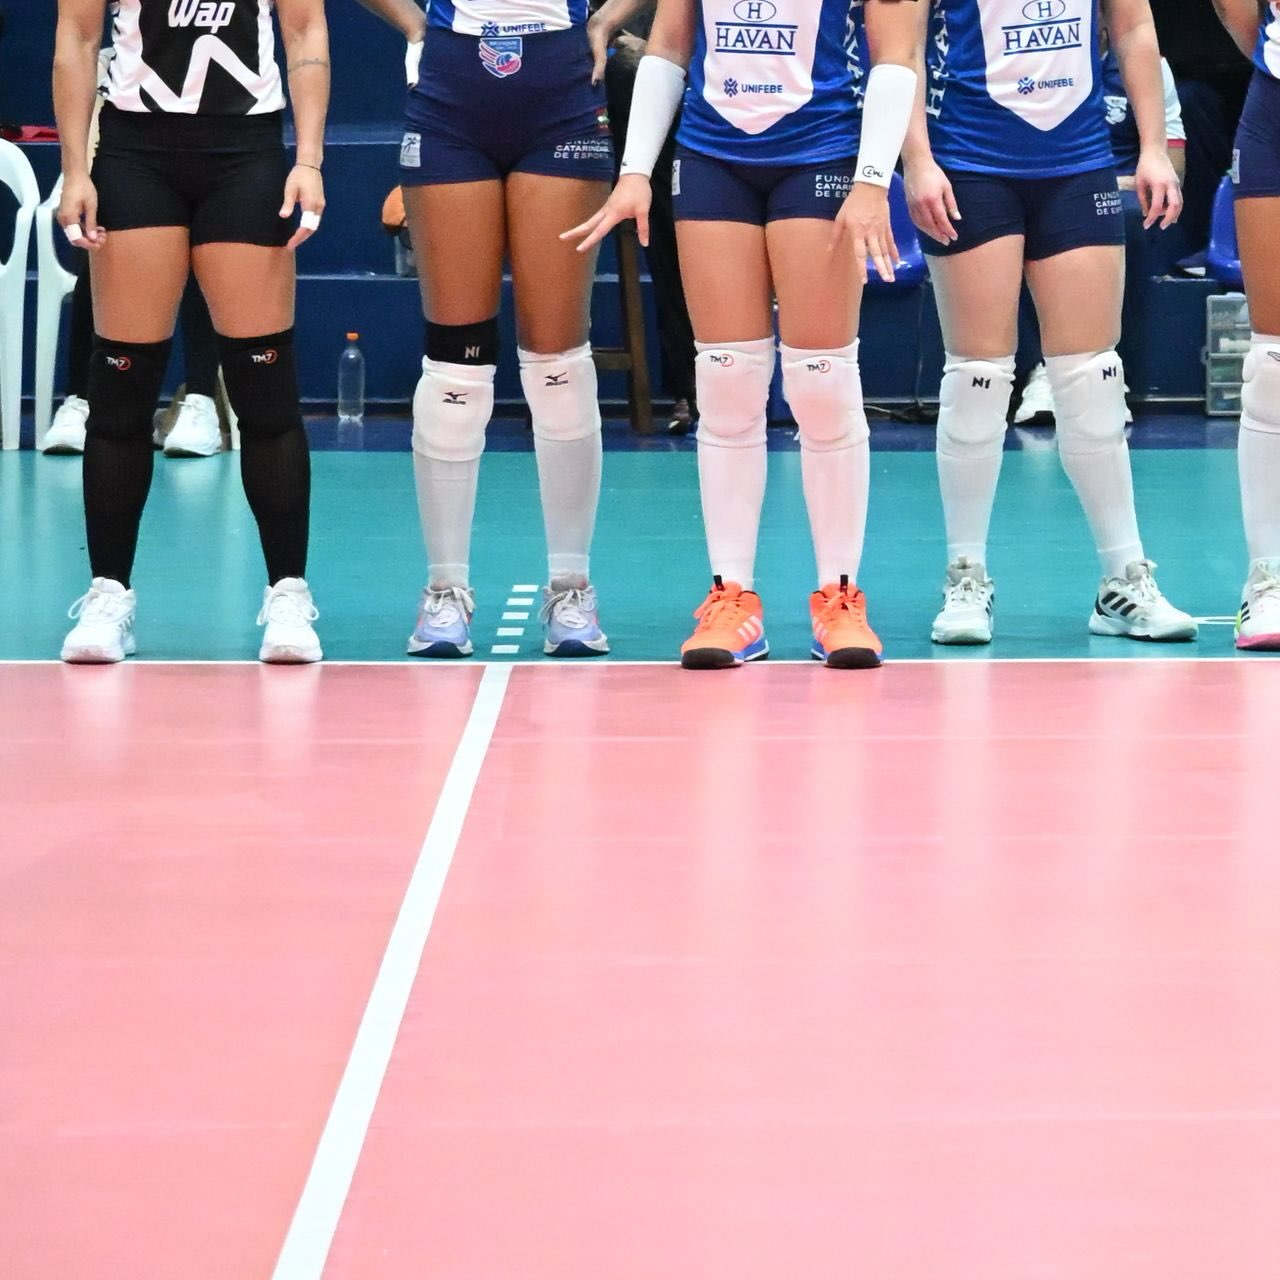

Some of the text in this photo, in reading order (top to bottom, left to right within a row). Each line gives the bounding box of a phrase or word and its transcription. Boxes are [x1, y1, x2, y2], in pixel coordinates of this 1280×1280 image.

[747, 2, 762, 19] H
[1038, 1, 1052, 18] H
[503, 23, 548, 33] UNIFEBE
[715, 27, 796, 50] HAVAN
[1004, 23, 1081, 50] HAVAN
[741, 83, 783, 94] UNIFEBE
[1038, 78, 1074, 89] UNIFEBE
[554, 151, 569, 159] DE
[816, 175, 854, 183] FUND
[815, 182, 853, 190] CATARI
[815, 190, 831, 198] DE
[1096, 207, 1110, 215] DE
[1102, 366, 1117, 381] N1
[972, 377, 991, 390] N1
